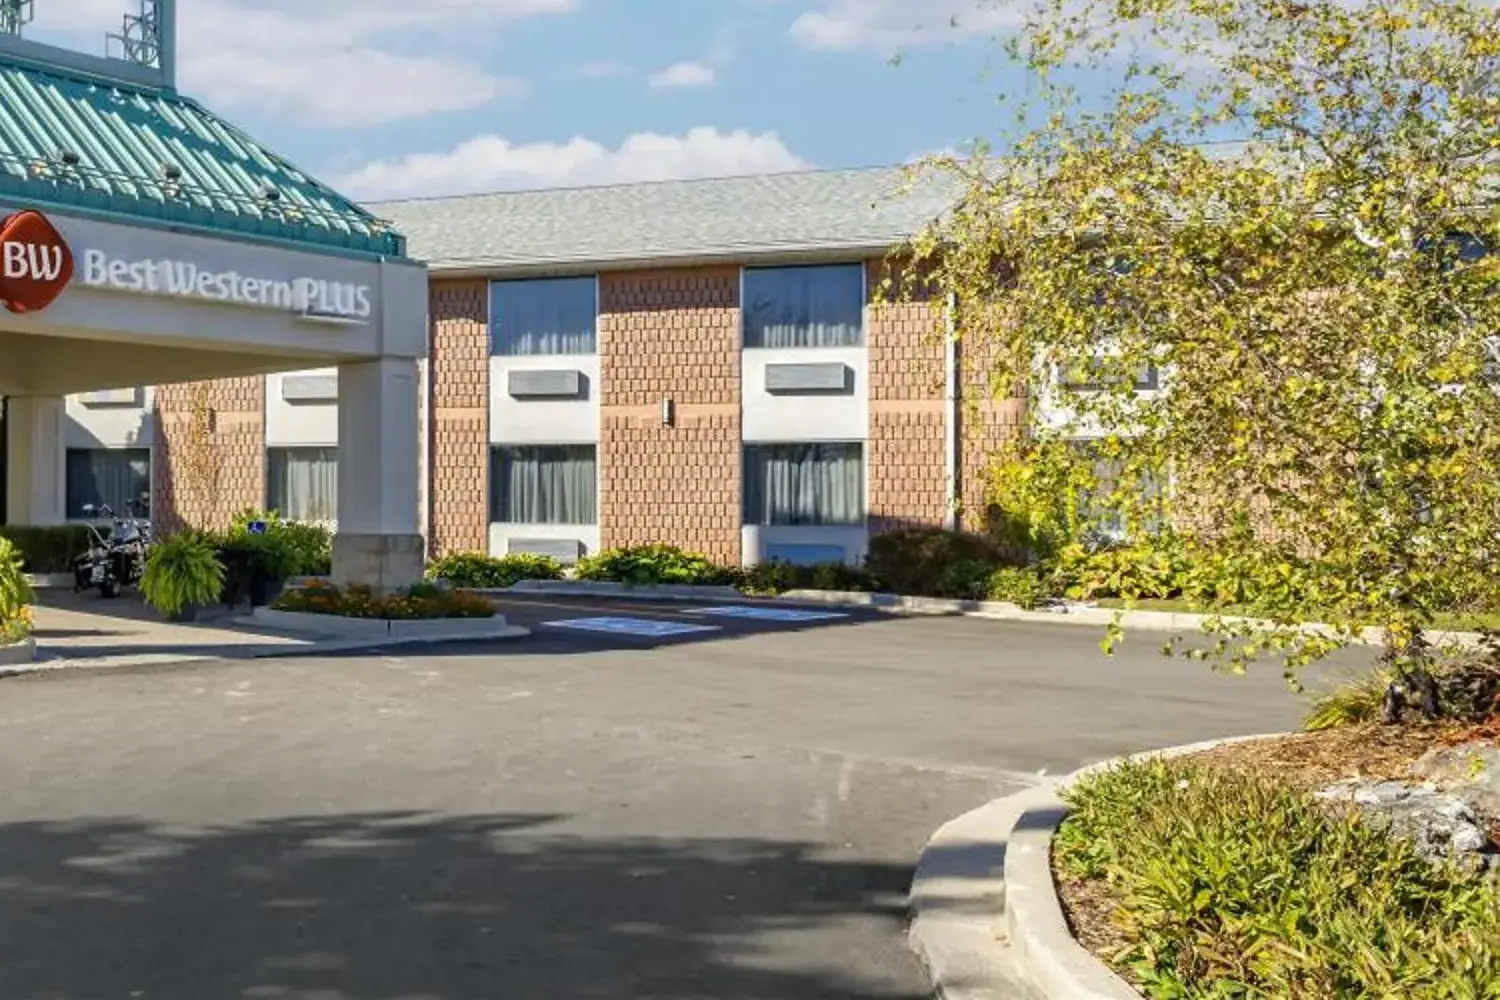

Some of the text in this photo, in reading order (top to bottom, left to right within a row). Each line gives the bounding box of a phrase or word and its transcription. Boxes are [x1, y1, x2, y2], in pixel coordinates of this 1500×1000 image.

[3, 240, 63, 281] BW
[83, 248, 370, 317] Best Western PLUS
